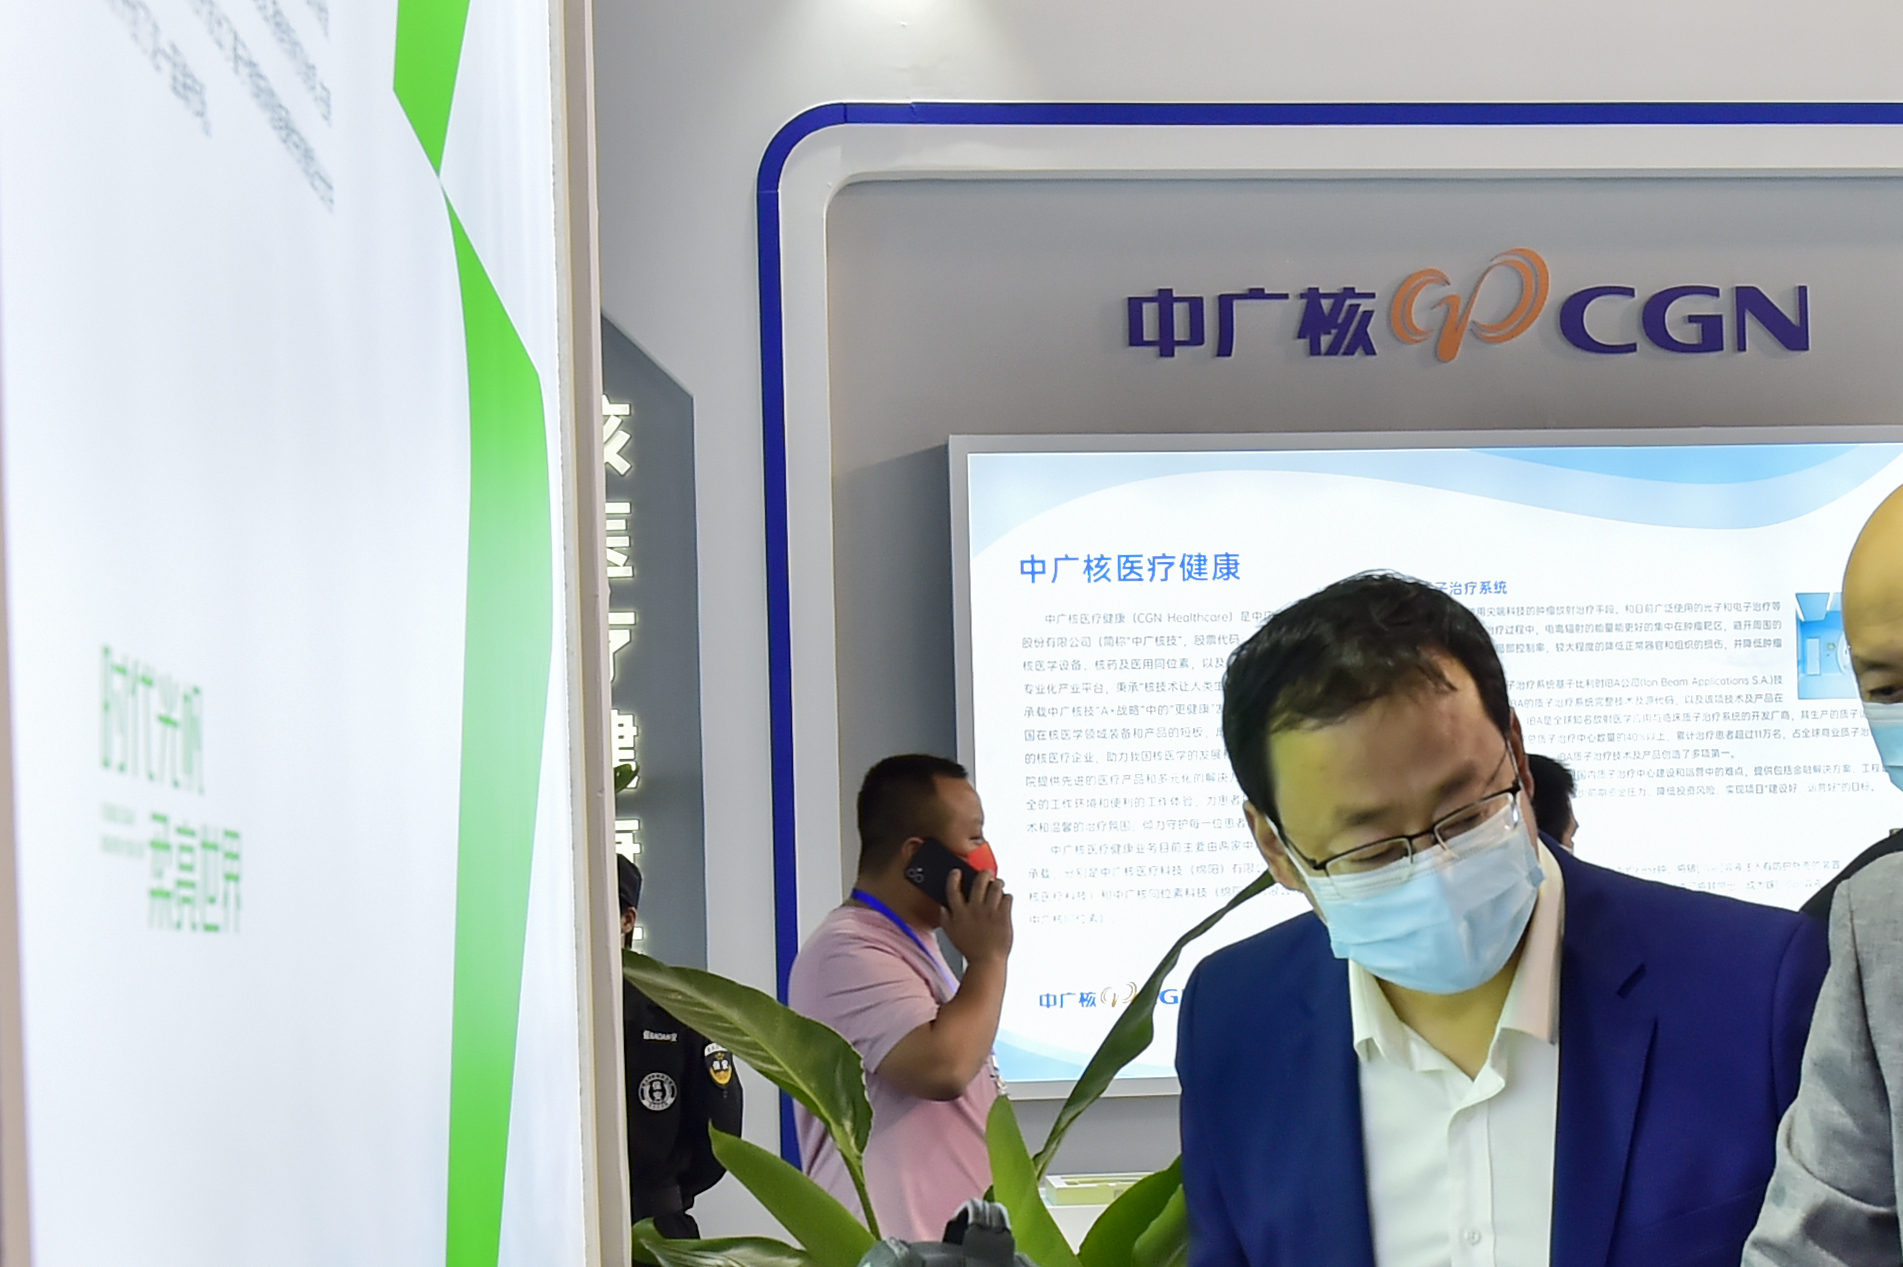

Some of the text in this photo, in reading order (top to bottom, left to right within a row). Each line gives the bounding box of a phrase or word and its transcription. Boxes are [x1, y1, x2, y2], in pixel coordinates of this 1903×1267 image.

[1126, 285, 1810, 357] 中广核 CGN
[1020, 552, 1241, 583] 中广核医疗健康
[1039, 991, 1098, 1009] 中广核
